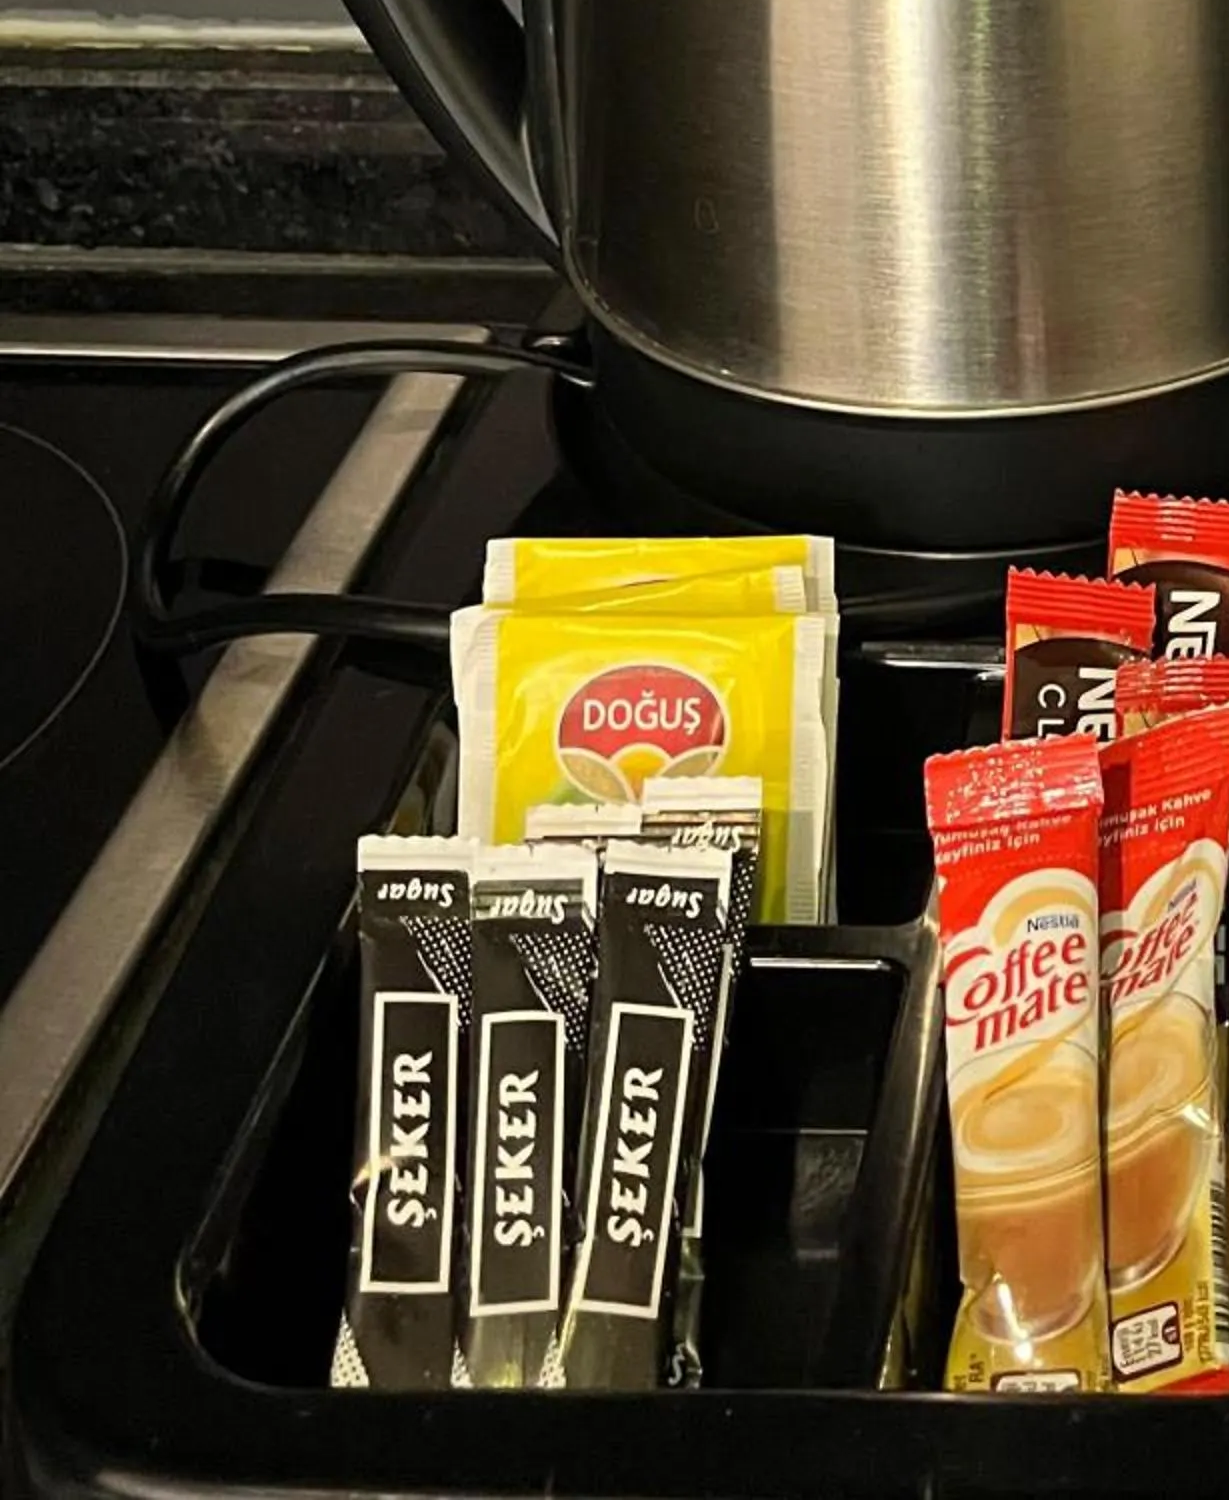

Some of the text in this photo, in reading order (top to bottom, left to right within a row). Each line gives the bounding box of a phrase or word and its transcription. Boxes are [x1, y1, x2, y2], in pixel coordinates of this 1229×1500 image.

[583, 690, 701, 734] DOĞUŞ
[1162, 789, 1212, 812] Kahve
[378, 883, 454, 907] Sugar
[490, 893, 568, 924] Sugar
[627, 888, 703, 918] Sugar
[945, 933, 1087, 1027] Coffee
[975, 971, 1088, 1051] mate
[387, 1050, 436, 1228] ŞEKER
[495, 1070, 544, 1247] ŞEKER
[607, 1067, 664, 1247] ŞEKER
